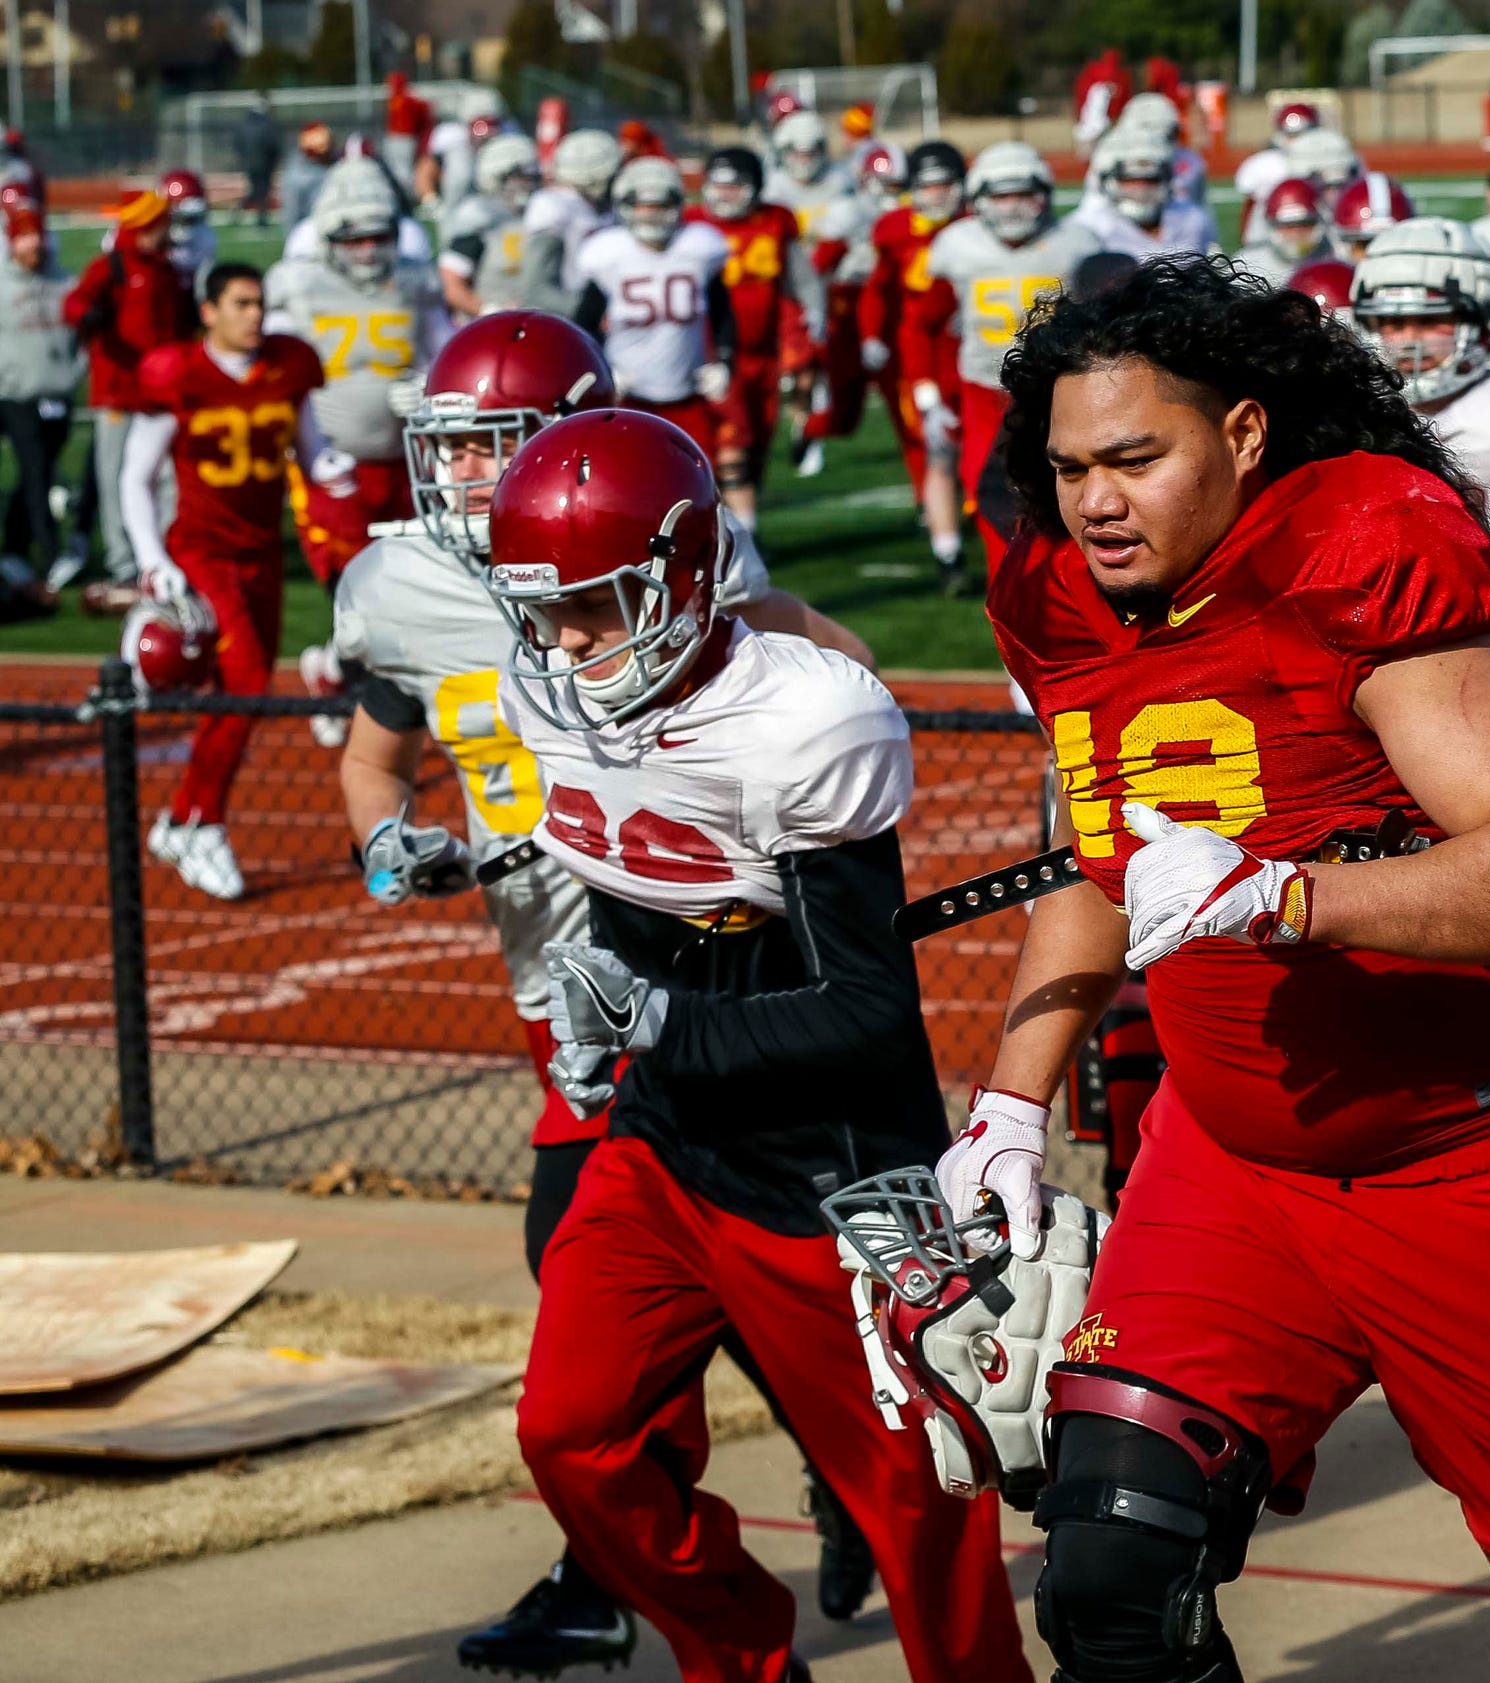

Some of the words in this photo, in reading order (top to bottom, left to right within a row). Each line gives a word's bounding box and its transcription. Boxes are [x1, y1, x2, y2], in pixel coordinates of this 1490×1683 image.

[620, 273, 698, 328] 50
[313, 312, 414, 380] 75
[188, 402, 296, 487] 33
[1066, 1327, 1119, 1362] STATE
[1192, 1594, 1205, 1646] FUSION
